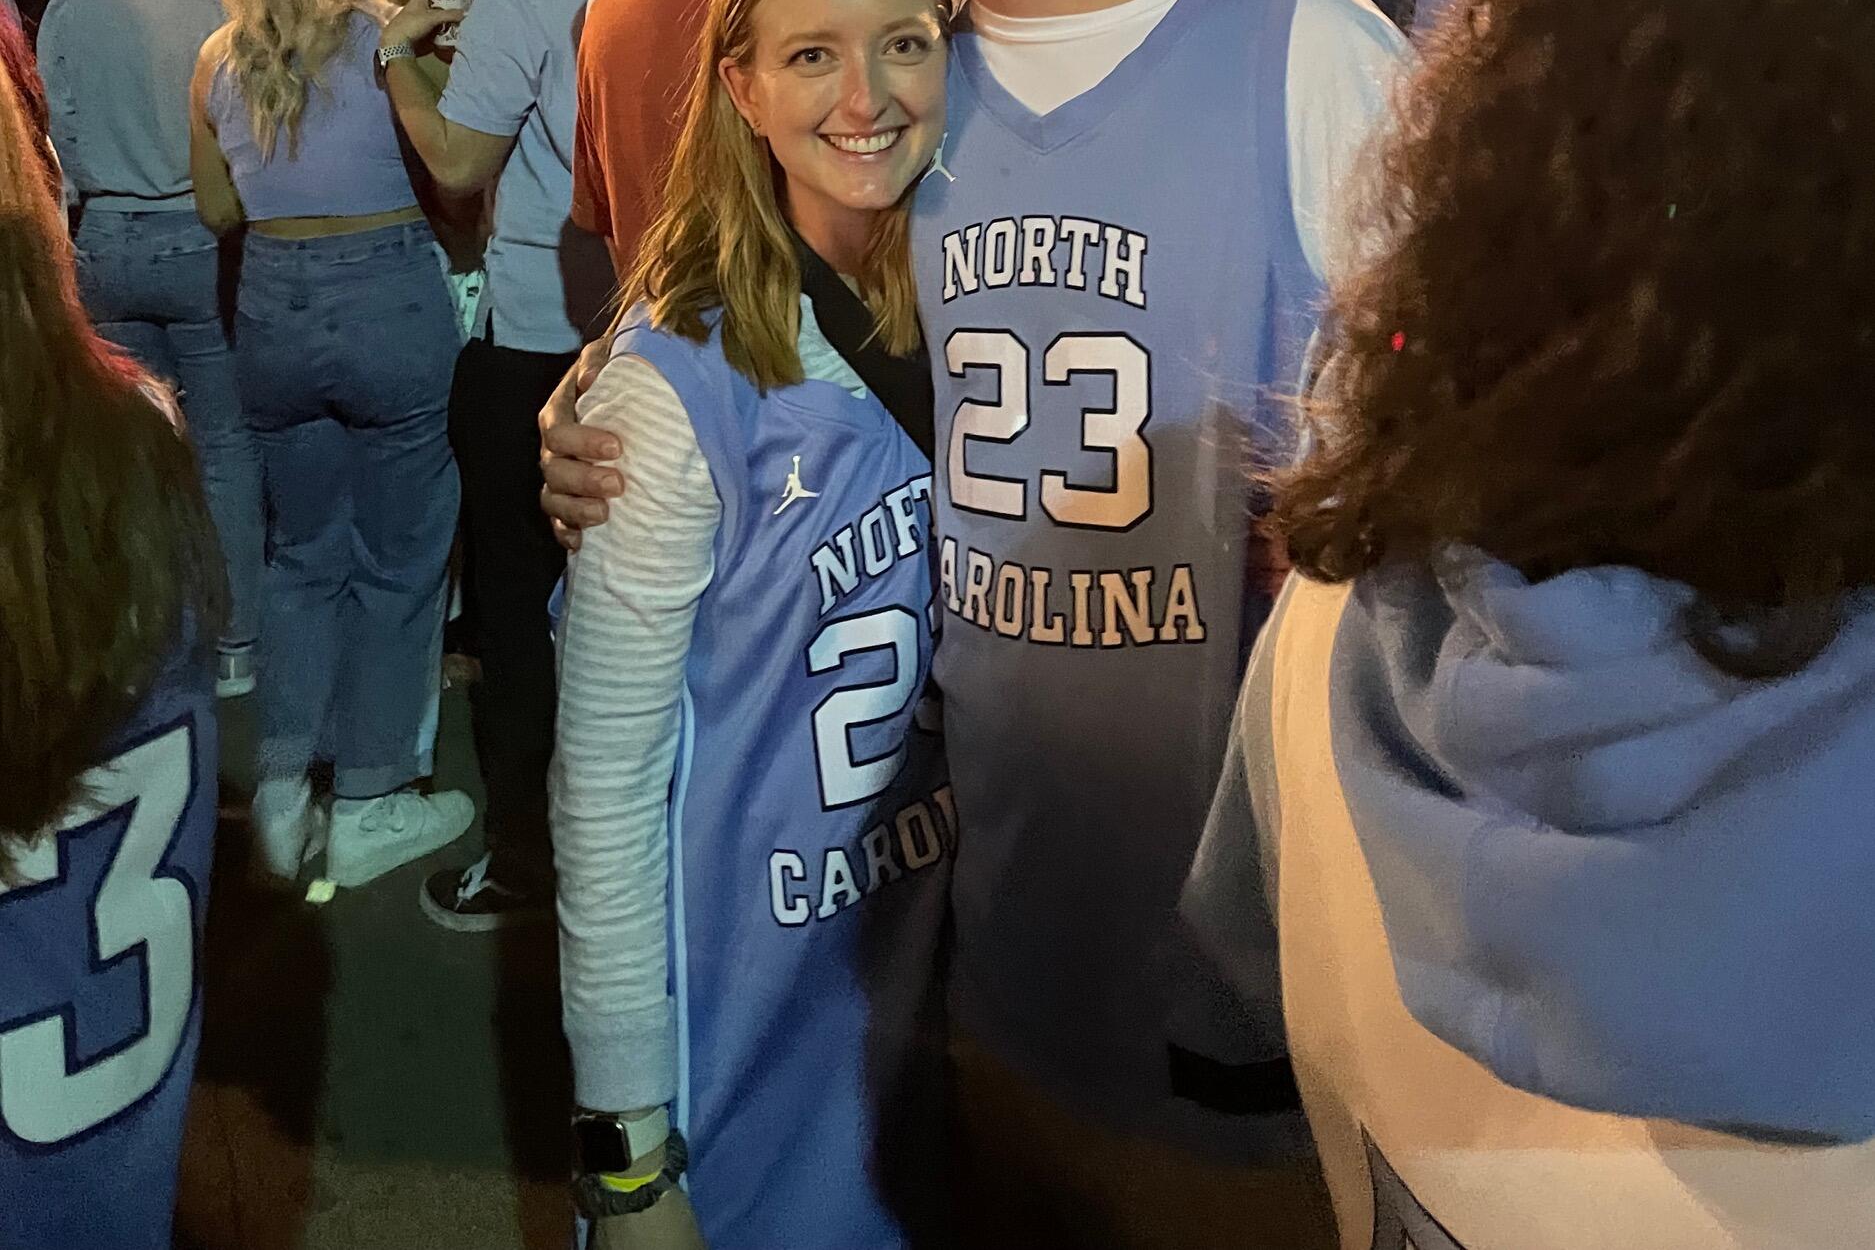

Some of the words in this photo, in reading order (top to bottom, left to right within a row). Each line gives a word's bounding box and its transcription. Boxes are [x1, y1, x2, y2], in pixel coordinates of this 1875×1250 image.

[941, 214, 1148, 310] NORTH
[943, 326, 1154, 533] 23
[940, 535, 1207, 649] AROLINA
[805, 603, 941, 813] 2
